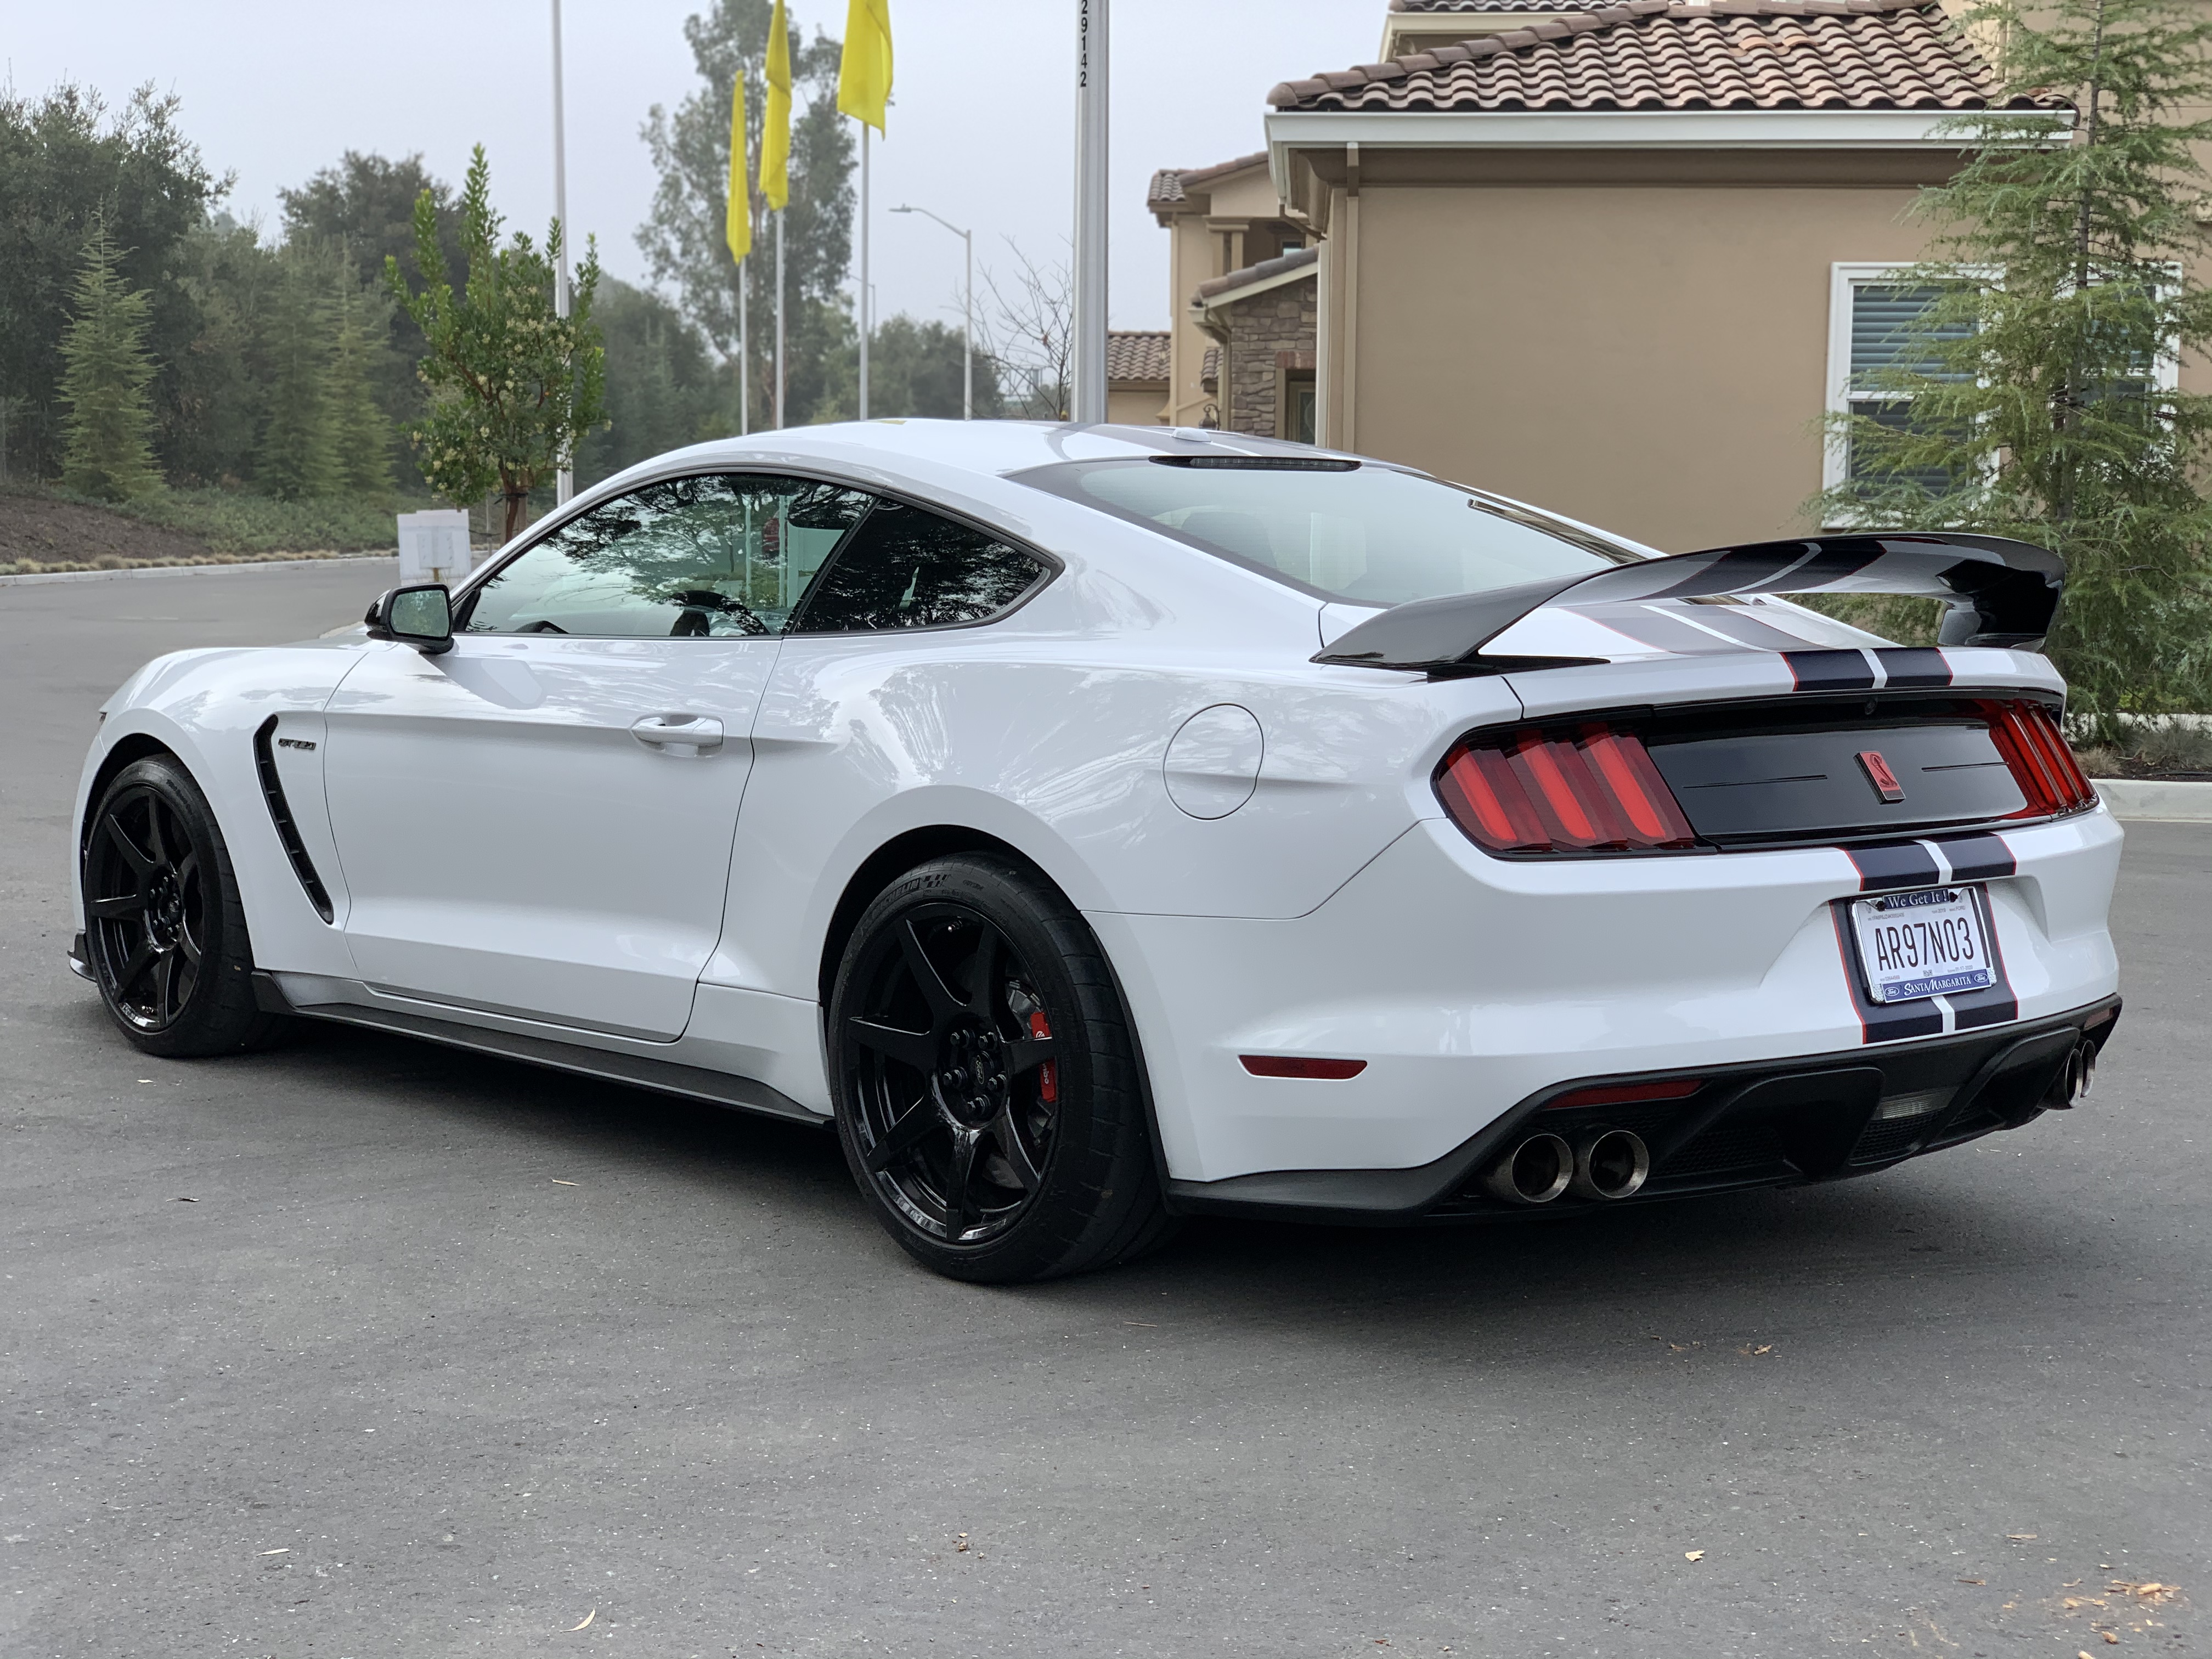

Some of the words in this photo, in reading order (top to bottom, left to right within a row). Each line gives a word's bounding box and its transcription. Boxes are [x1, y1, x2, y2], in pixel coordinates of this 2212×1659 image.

[1080, 0, 1088, 87] 29142
[1888, 896, 1906, 909] We
[1909, 894, 1928, 905] Get
[1875, 917, 1974, 971] AR97N03
[1904, 983, 1928, 996] SANTA
[1927, 976, 1971, 993] MARGARITA
